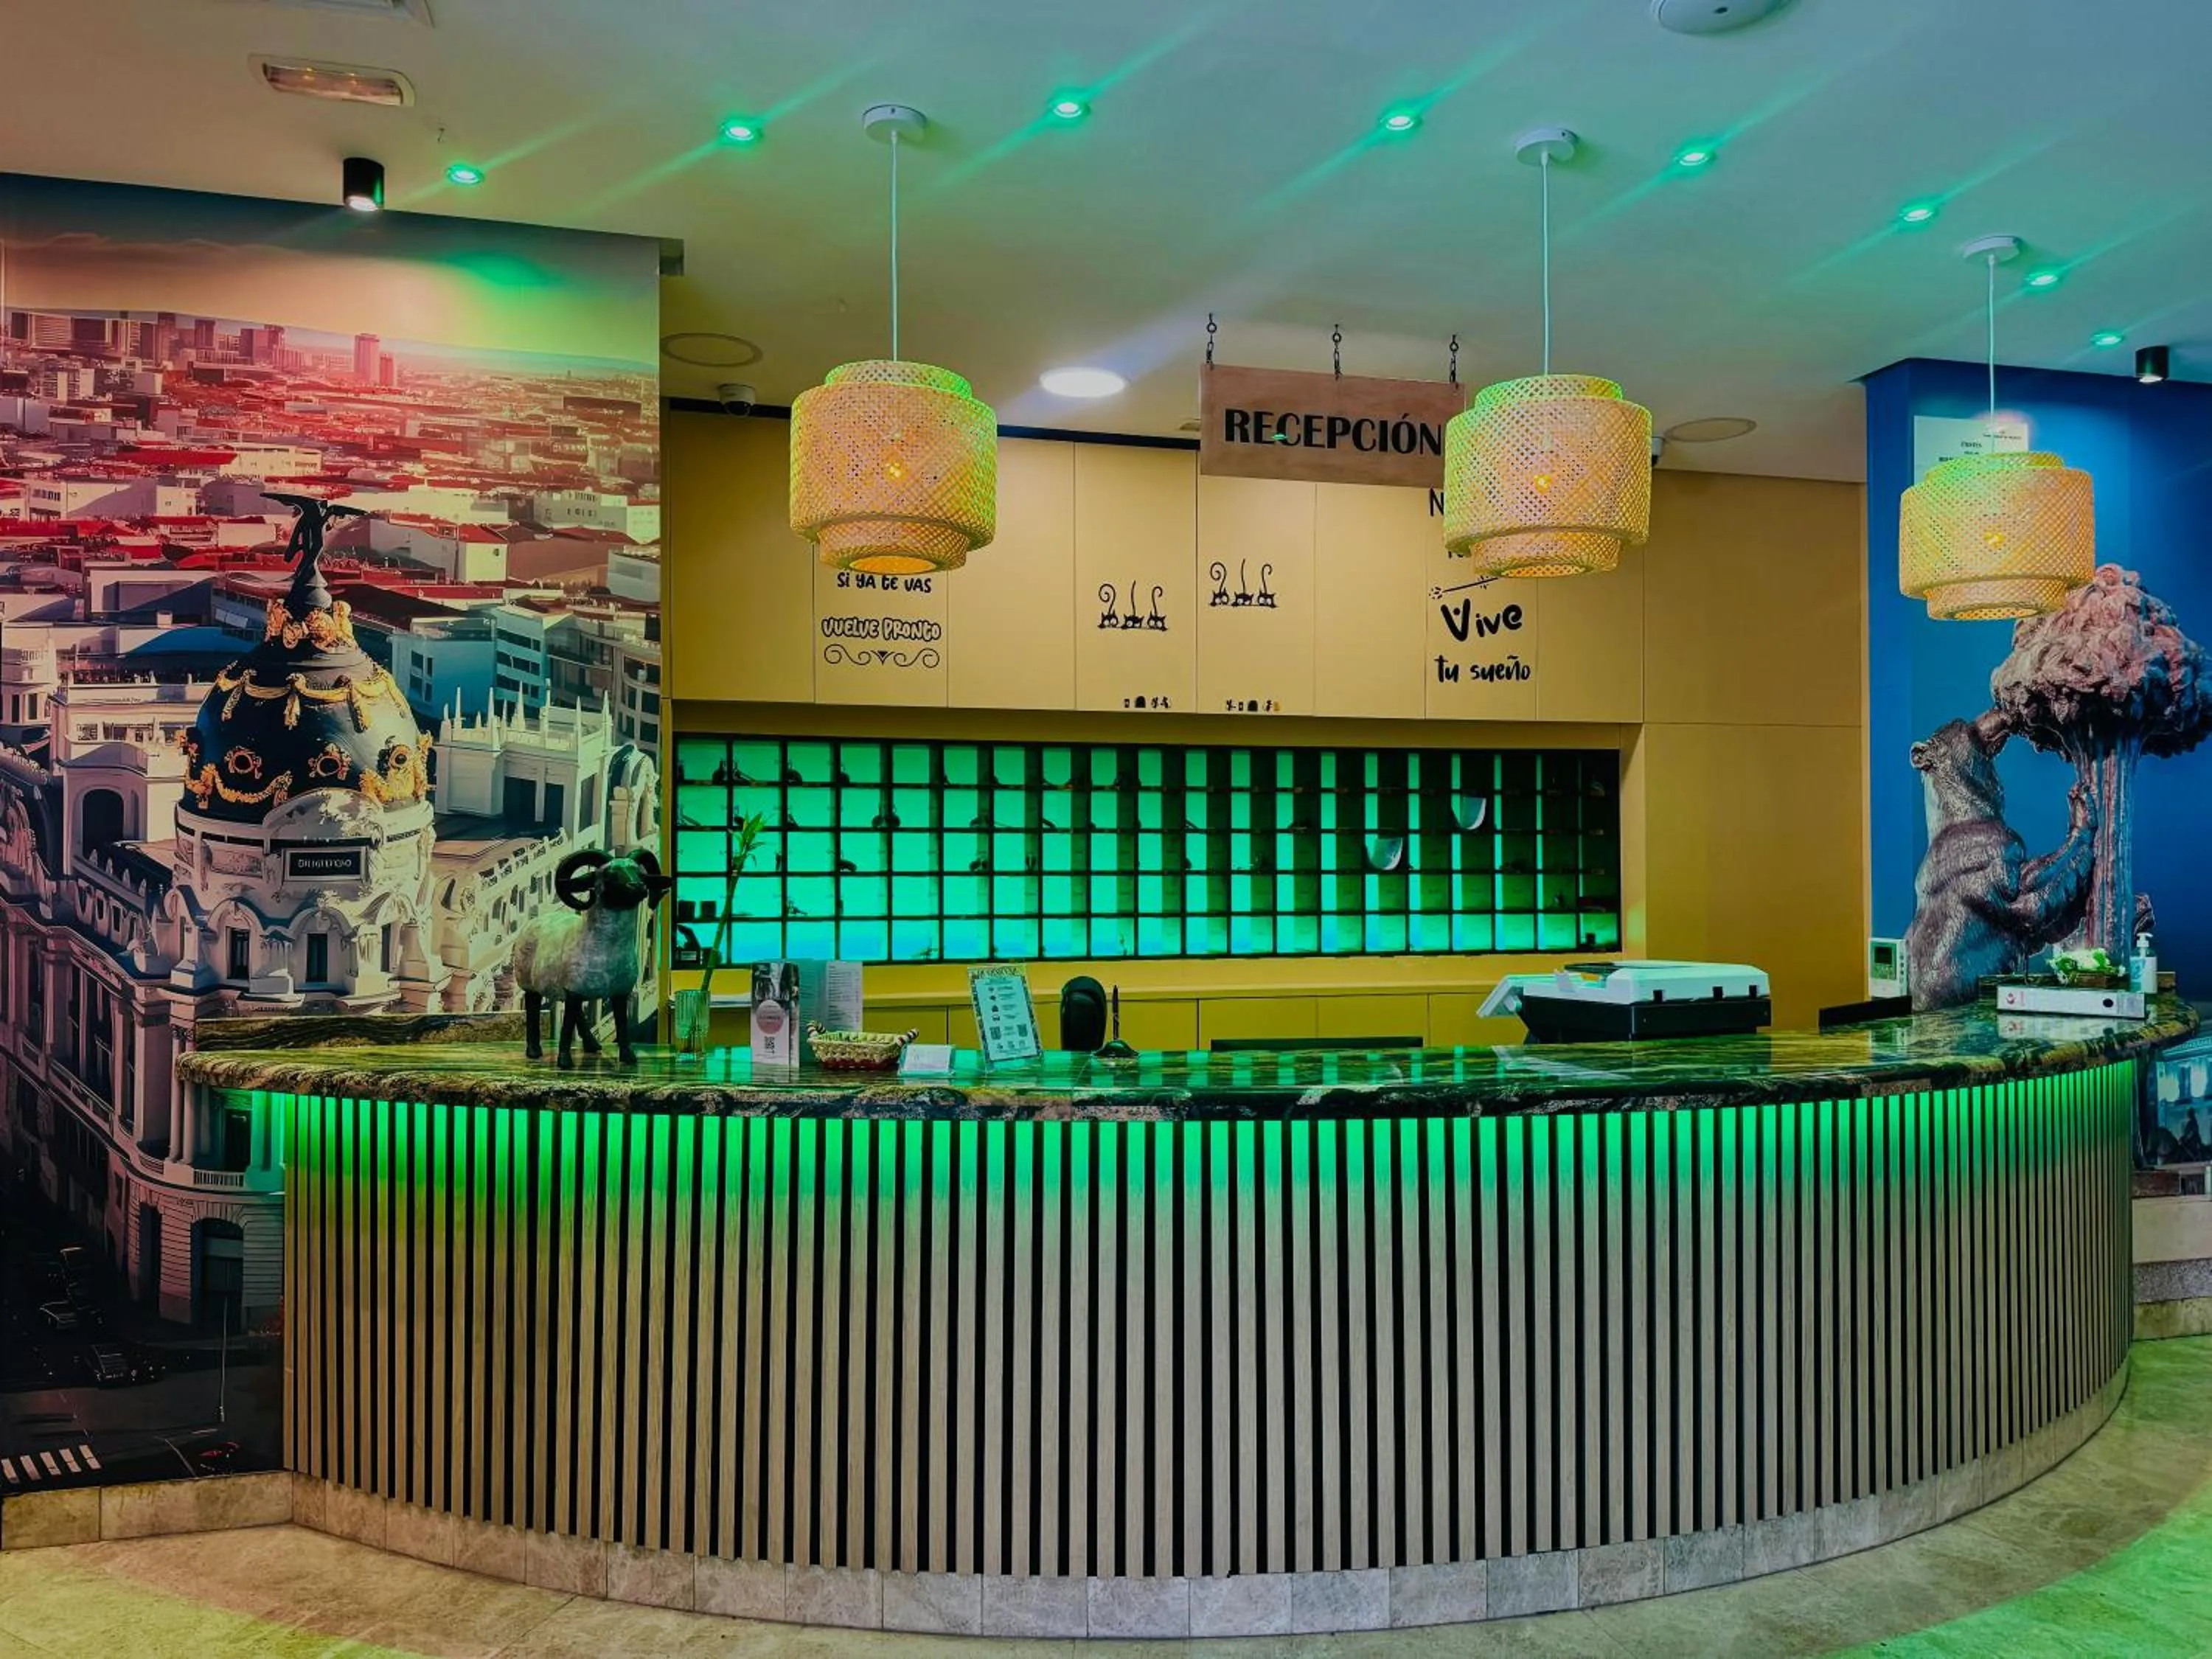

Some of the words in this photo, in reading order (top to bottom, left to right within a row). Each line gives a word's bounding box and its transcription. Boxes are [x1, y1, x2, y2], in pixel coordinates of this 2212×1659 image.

[1225, 408, 1441, 456] RECEPCIÓN
[905, 578, 931, 593] VAS
[821, 616, 880, 639] VUELVE
[1441, 599, 1522, 641] Vive
[1434, 655, 1459, 683] tu
[1470, 655, 1531, 683] sueño
